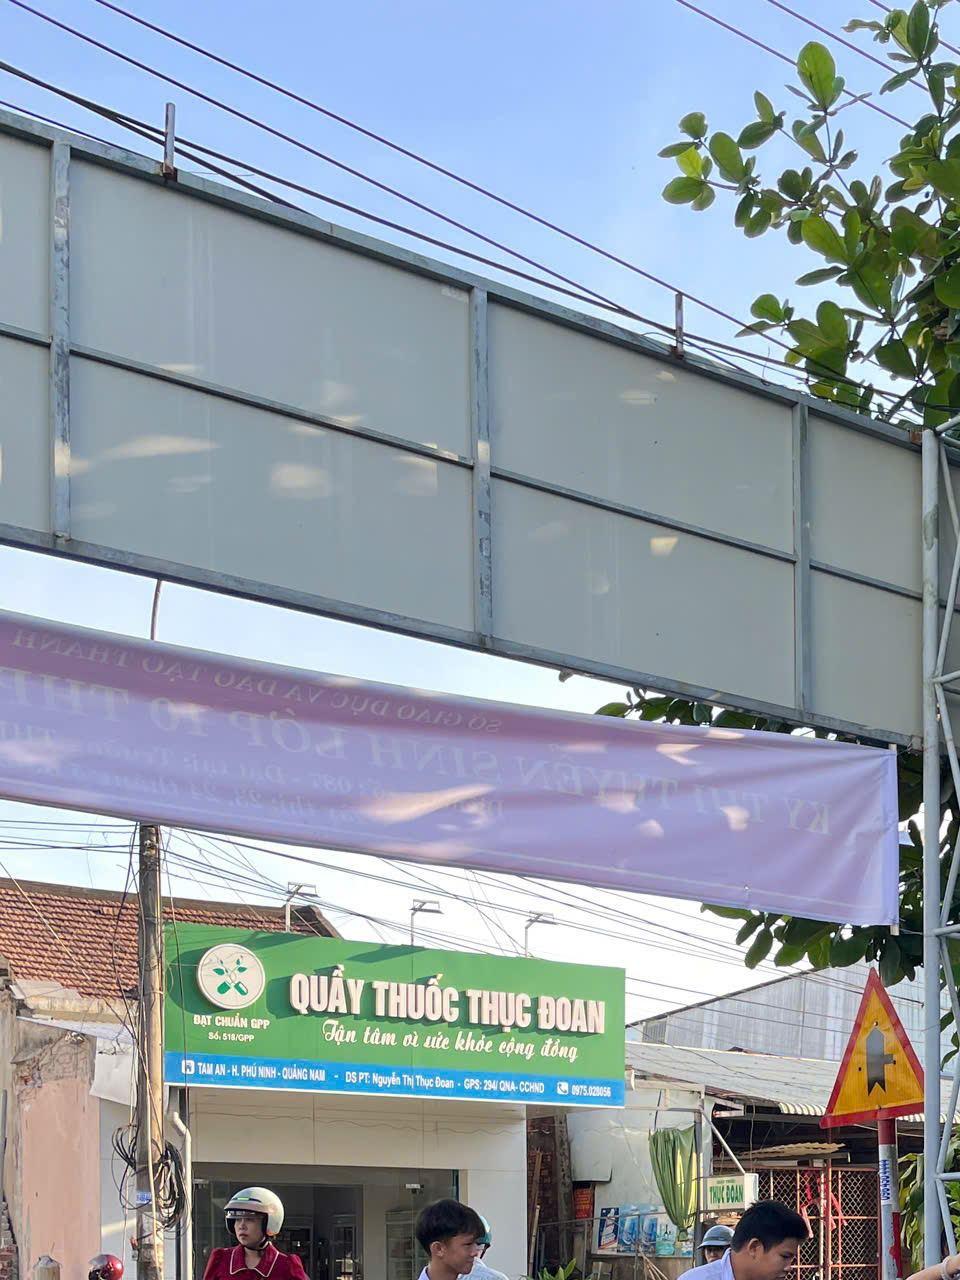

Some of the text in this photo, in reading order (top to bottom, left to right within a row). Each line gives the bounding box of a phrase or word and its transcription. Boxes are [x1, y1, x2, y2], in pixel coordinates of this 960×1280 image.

[290, 964, 605, 1034] QUẦY THUỐC THỤC ĐOAN
[193, 1013, 270, 1029] ĐẠT CHUẨN GPP
[322, 1019, 357, 1045] Tận
[363, 1026, 397, 1046] tâm
[402, 1031, 419, 1047] vì
[424, 1031, 450, 1050] sức
[498, 1037, 535, 1058] cộng
[541, 1037, 578, 1063] đồng
[197, 1062, 213, 1075] TAM
[215, 1064, 226, 1076] AN
[231, 1066, 240, 1077] H.
[241, 1063, 257, 1078] PHÚ
[258, 1067, 276, 1079] NINH
[282, 1064, 308, 1080] QUẢNG
[309, 1069, 326, 1081] NAM
[345, 1071, 357, 1084] DS
[358, 1072, 370, 1084] PT:
[372, 1071, 400, 1088] Nguyễn
[402, 1074, 414, 1088] Thị
[416, 1075, 434, 1089] Thục
[435, 1076, 454, 1089] Đoan
